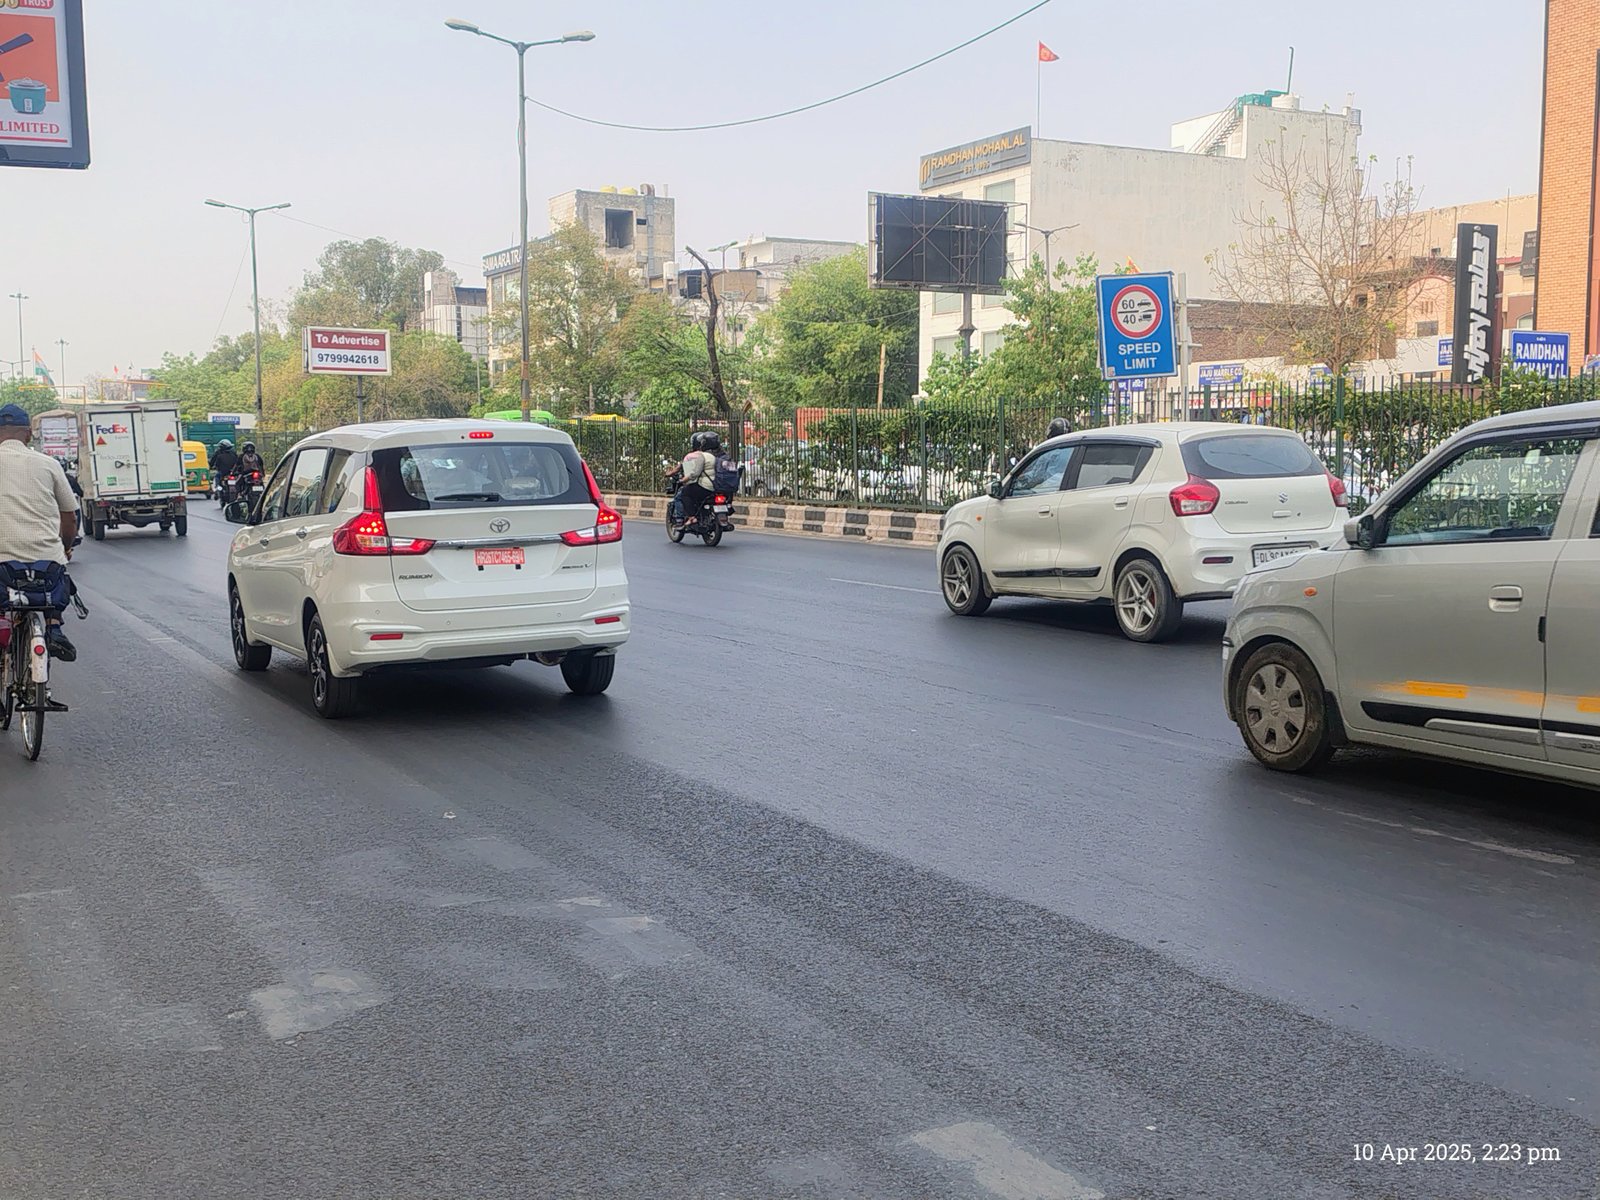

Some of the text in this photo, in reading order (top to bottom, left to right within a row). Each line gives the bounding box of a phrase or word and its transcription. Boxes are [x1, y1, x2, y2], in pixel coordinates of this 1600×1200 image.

[0, 121, 60, 134] LIMITED
[931, 133, 1026, 169] RAMDHAN MOHANLAL
[1121, 299, 1135, 310] 60
[1122, 314, 1136, 325] 40
[315, 333, 380, 346] To Advertise
[1118, 342, 1161, 355] SPEED
[1516, 342, 1565, 361] RAMDHAN
[317, 353, 379, 365] 9799942618
[1124, 357, 1157, 370] LIMIT
[96, 424, 128, 434] FedEx
